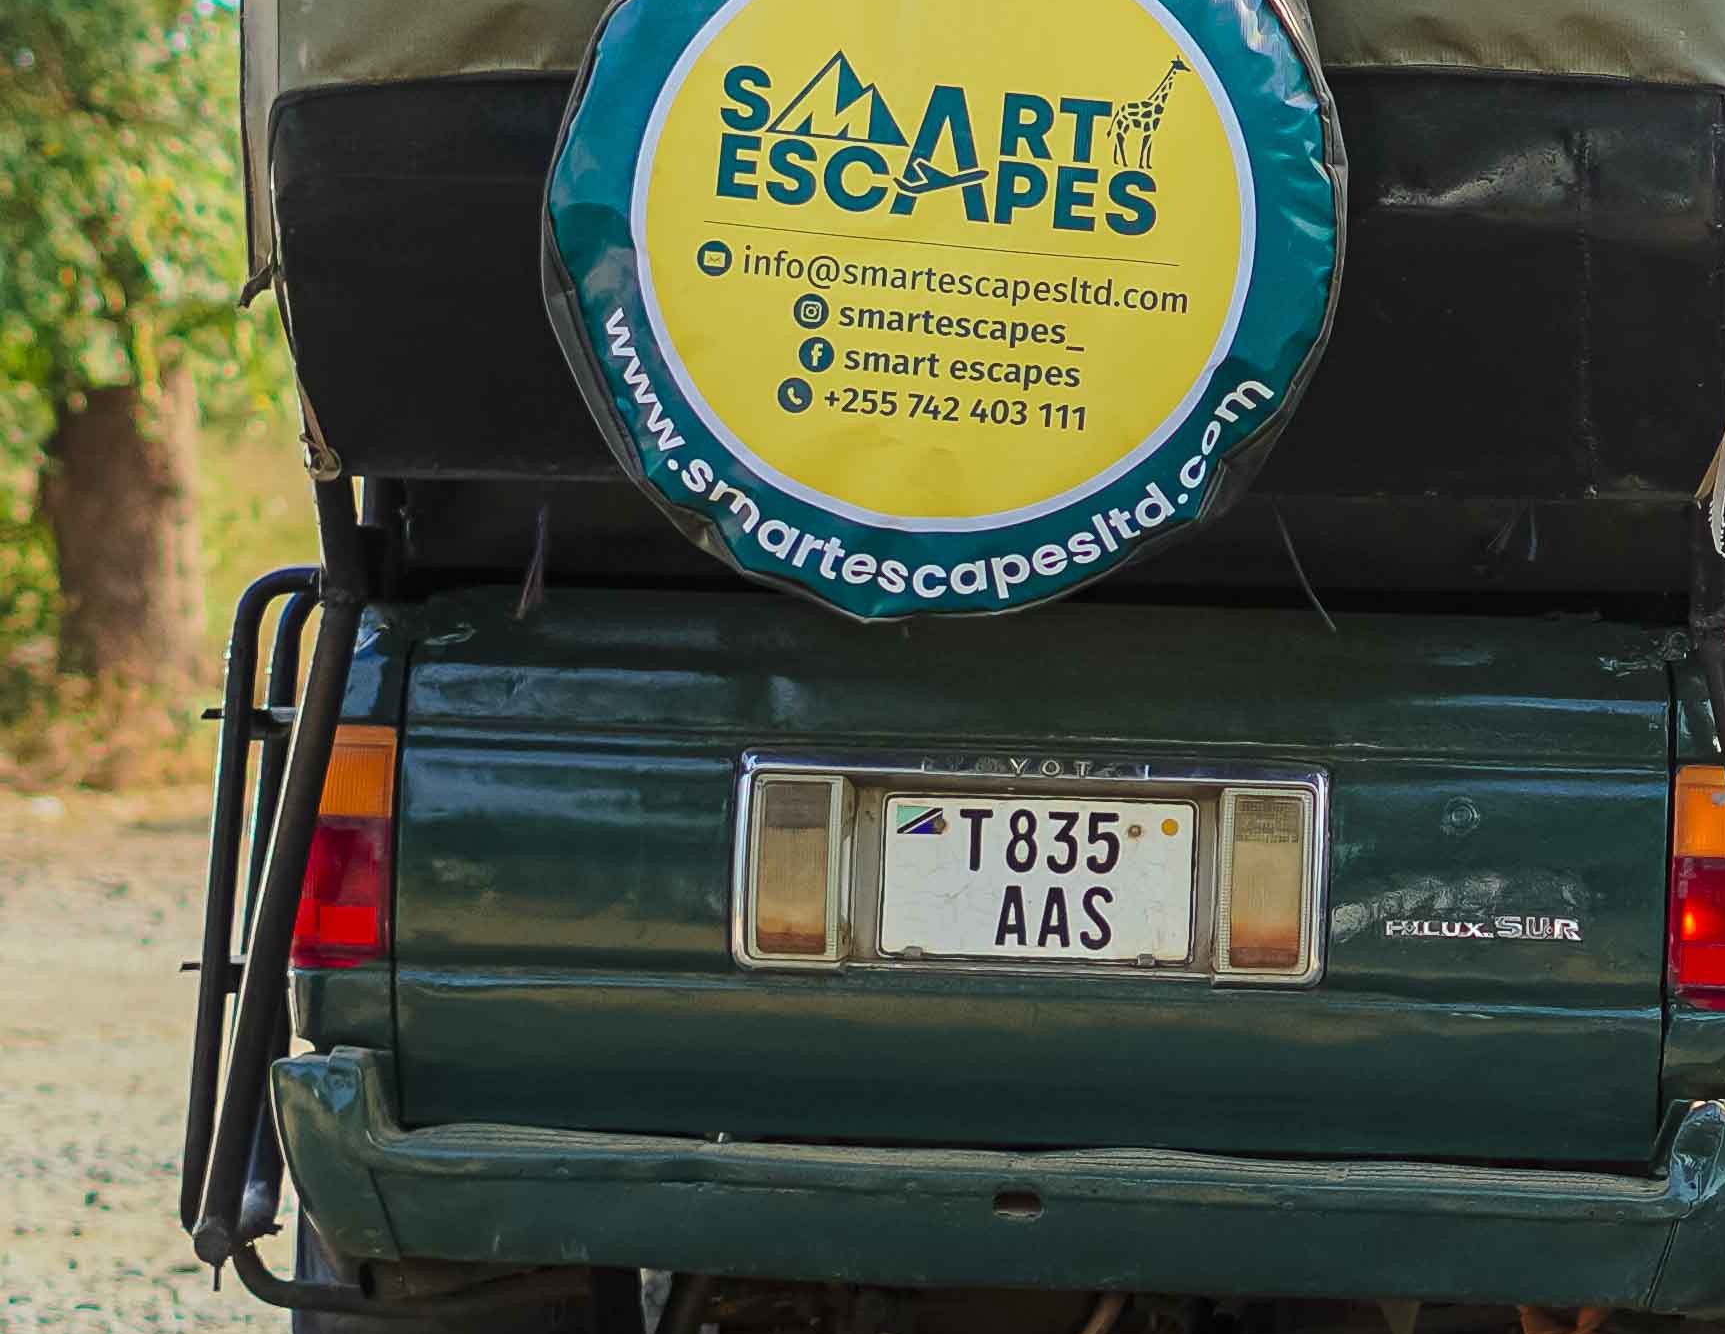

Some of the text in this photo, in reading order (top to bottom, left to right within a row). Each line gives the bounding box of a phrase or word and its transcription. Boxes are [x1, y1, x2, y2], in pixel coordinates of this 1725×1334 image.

[719, 50, 1112, 165] SMART
[715, 132, 1157, 236] ESCAPES
[743, 244, 1188, 314] info@smartescapesltd.com
[838, 301, 1085, 352] smartescapes_
[844, 350, 1081, 391] smart escapes
[824, 387, 1087, 431] +255 742 403 111
[603, 307, 1275, 599] www.smartescapesltd.com
[958, 807, 1122, 875] T835
[995, 885, 1114, 951] AAS
